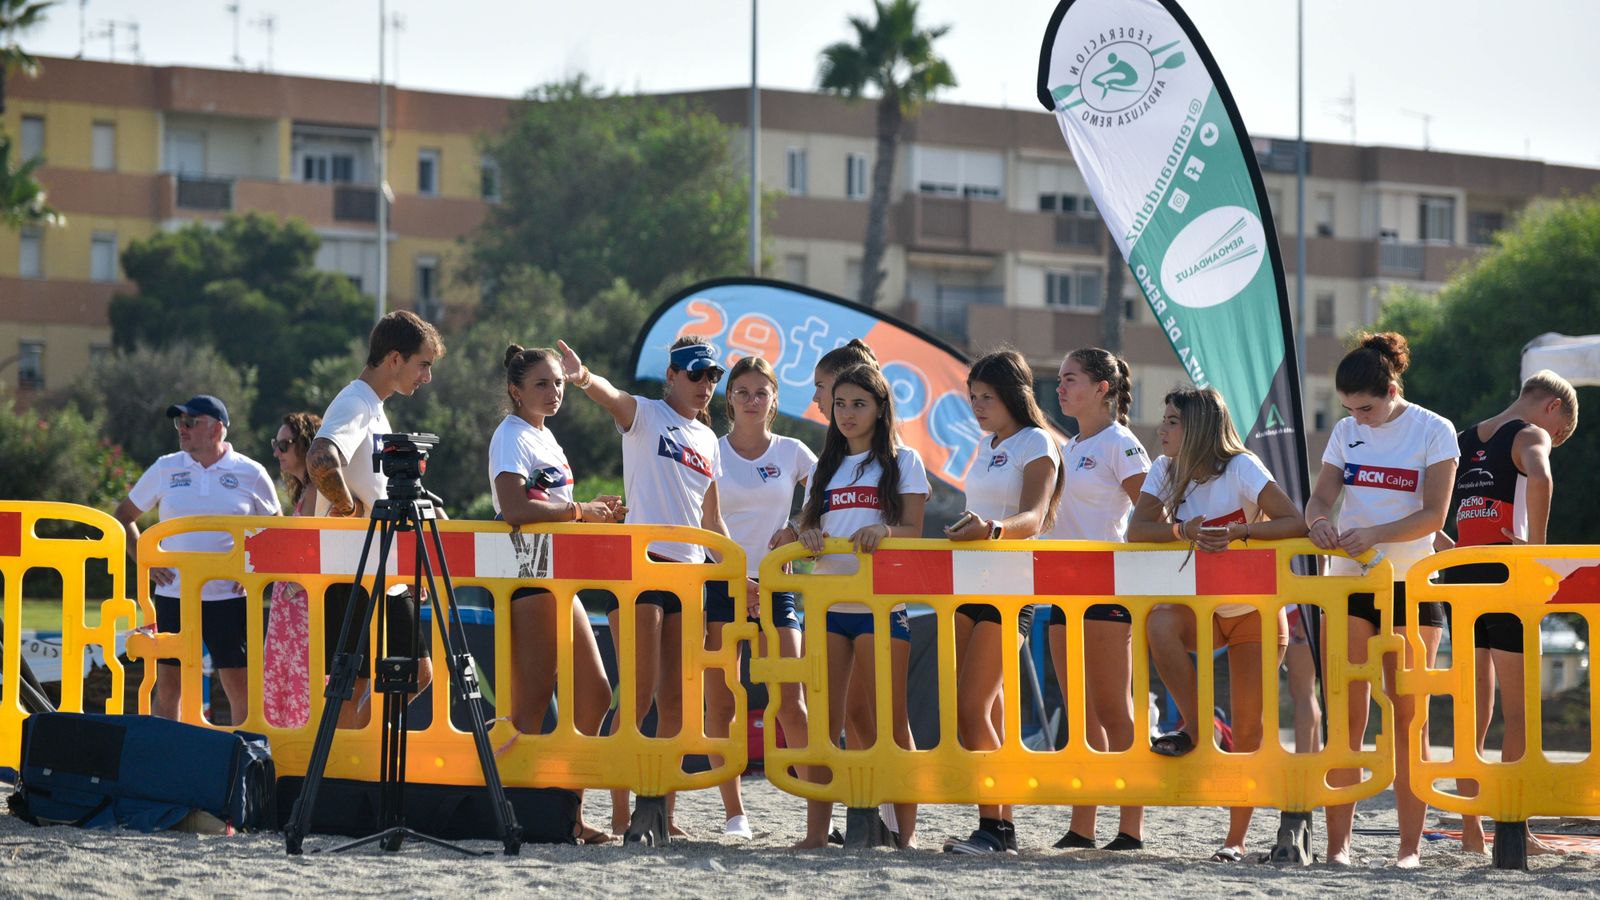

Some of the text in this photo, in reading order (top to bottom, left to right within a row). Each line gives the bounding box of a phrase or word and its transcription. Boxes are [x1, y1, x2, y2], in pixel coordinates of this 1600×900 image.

[1358, 470, 1415, 488] RCN Calpe
[832, 491, 879, 506] RCN Calp
[1461, 496, 1484, 507] REMO
[1457, 508, 1498, 520] ORREVIEJA
